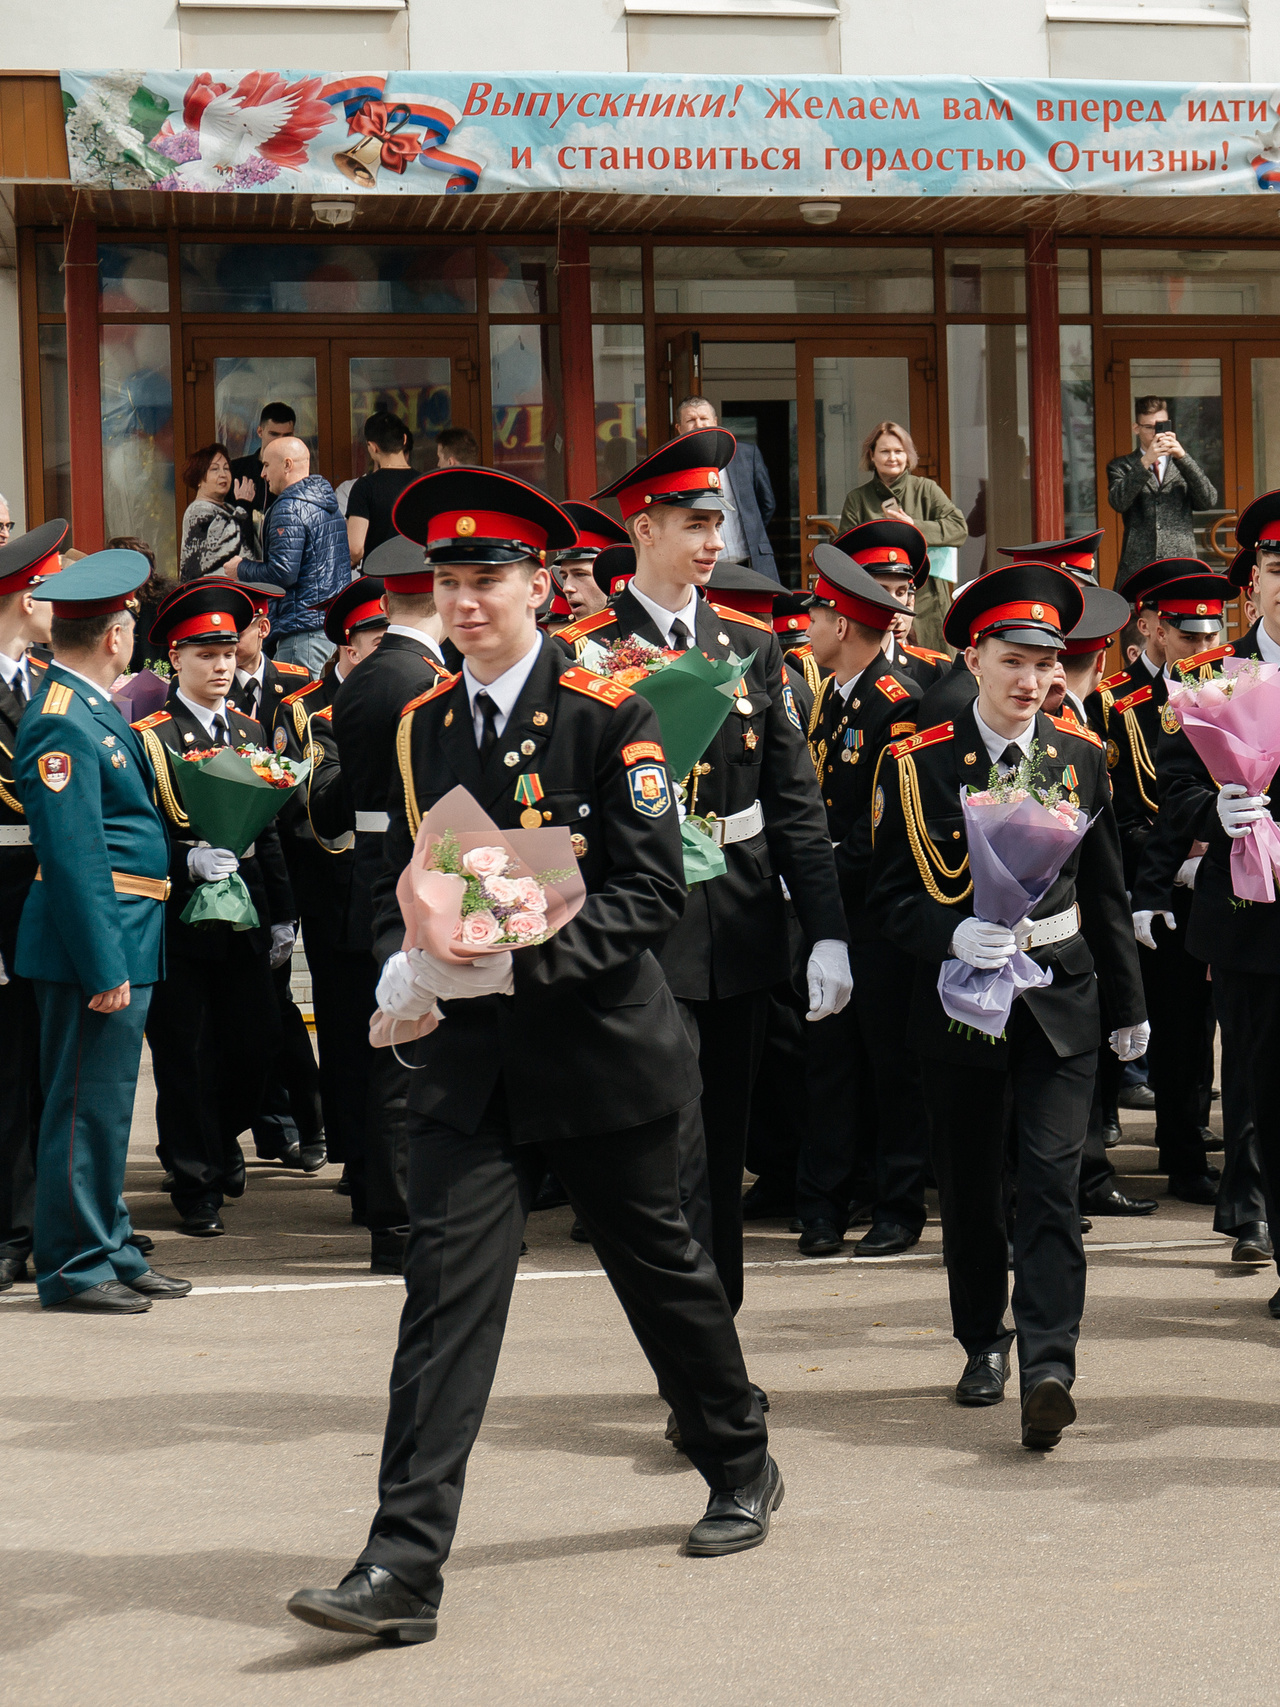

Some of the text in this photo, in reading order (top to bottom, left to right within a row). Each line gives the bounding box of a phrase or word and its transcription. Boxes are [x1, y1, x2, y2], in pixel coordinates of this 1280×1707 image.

[462, 82, 1267, 133] Выпускники! Желаем вам вперед идти
[511, 140, 1229, 182] и становиться гордостью Отчизны!
[602, 685, 625, 700] КК
[891, 689, 904, 698] КК
